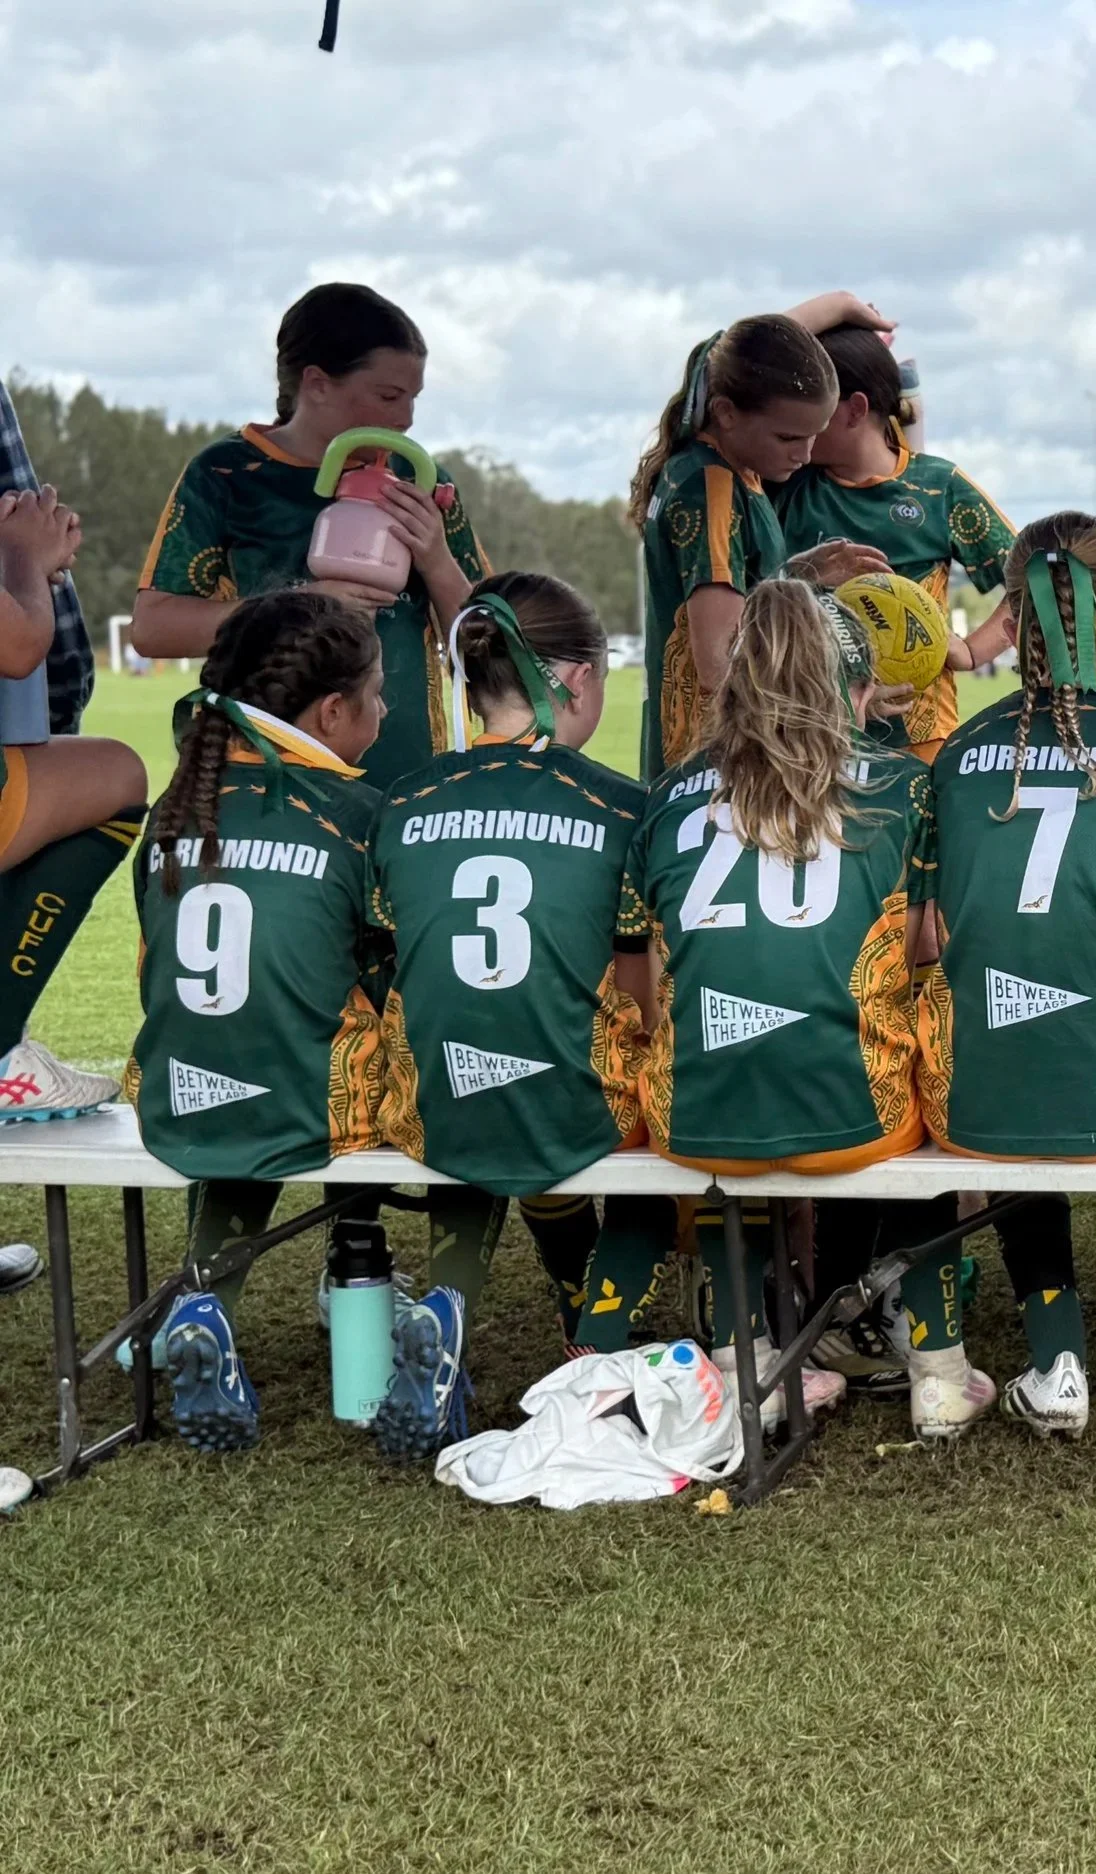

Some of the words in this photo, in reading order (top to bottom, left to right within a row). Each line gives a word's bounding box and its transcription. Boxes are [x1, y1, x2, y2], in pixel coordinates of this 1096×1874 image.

[401, 809, 607, 853] CURRIMUNDI
[676, 802, 843, 932] 20
[1016, 786, 1080, 914] 7
[11, 891, 67, 977] CUFC
[451, 854, 534, 991] 3
[175, 881, 254, 1017] 9
[994, 975, 1068, 1000] BETWEEN
[709, 995, 785, 1020] BETWEEN
[995, 1002, 1022, 1022] THE
[1027, 999, 1068, 1015] FLAGS
[710, 1023, 740, 1044] THE
[743, 1017, 785, 1036] FLAGS
[454, 1048, 530, 1071] BETWEEN
[176, 1066, 248, 1092] BETWEEN
[458, 1072, 486, 1092] THE
[490, 1068, 531, 1086] FLAGS
[178, 1092, 205, 1111] THE
[209, 1090, 248, 1105] FLAGS
[628, 1262, 667, 1325] CUFC
[938, 1263, 959, 1338] CUFC
